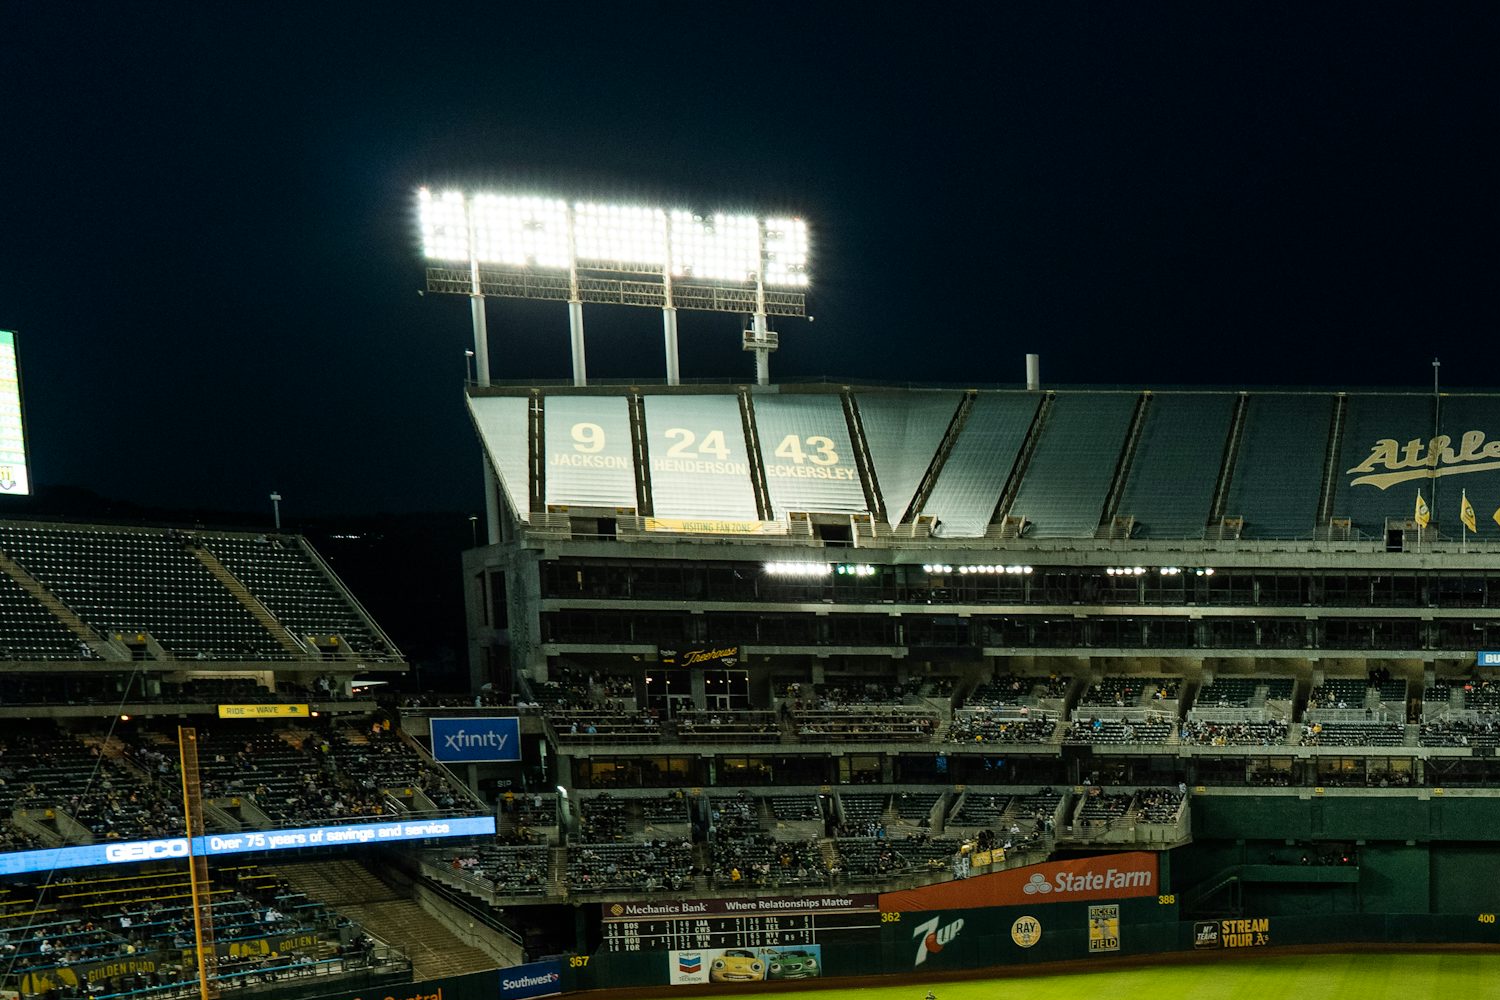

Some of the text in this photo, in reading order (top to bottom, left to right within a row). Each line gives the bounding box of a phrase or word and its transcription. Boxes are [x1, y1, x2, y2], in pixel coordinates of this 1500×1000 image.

[570, 422, 605, 452] 9
[664, 428, 730, 460] 24
[774, 434, 839, 466] 43
[550, 454, 628, 469] JACKSON
[654, 460, 746, 476] HENDERSON
[767, 464, 854, 480] ECKERSLEY
[682, 522, 752, 532] VISITING FAN ZONE
[681, 647, 737, 666] Treehouse
[226, 706, 279, 715] RIDE WAVE
[444, 730, 508, 750] xfinity
[106, 822, 450, 863] GEICO Over 75 years of savings and service
[626, 904, 679, 914] Mechanics
[682, 903, 706, 912] Bank
[726, 900, 757, 910] Where
[758, 900, 819, 909] Relationships
[1158, 895, 1175, 904] 388
[881, 912, 901, 923] 362
[1478, 914, 1496, 924] 400
[1016, 922, 1036, 933] RAY
[1222, 919, 1269, 934] STREAM
[1092, 938, 1116, 948] FIELD
[1222, 933, 1253, 948] YOUR
[1254, 933, 1270, 945] A's
[570, 956, 590, 968] 367
[503, 974, 552, 990] Southwest
